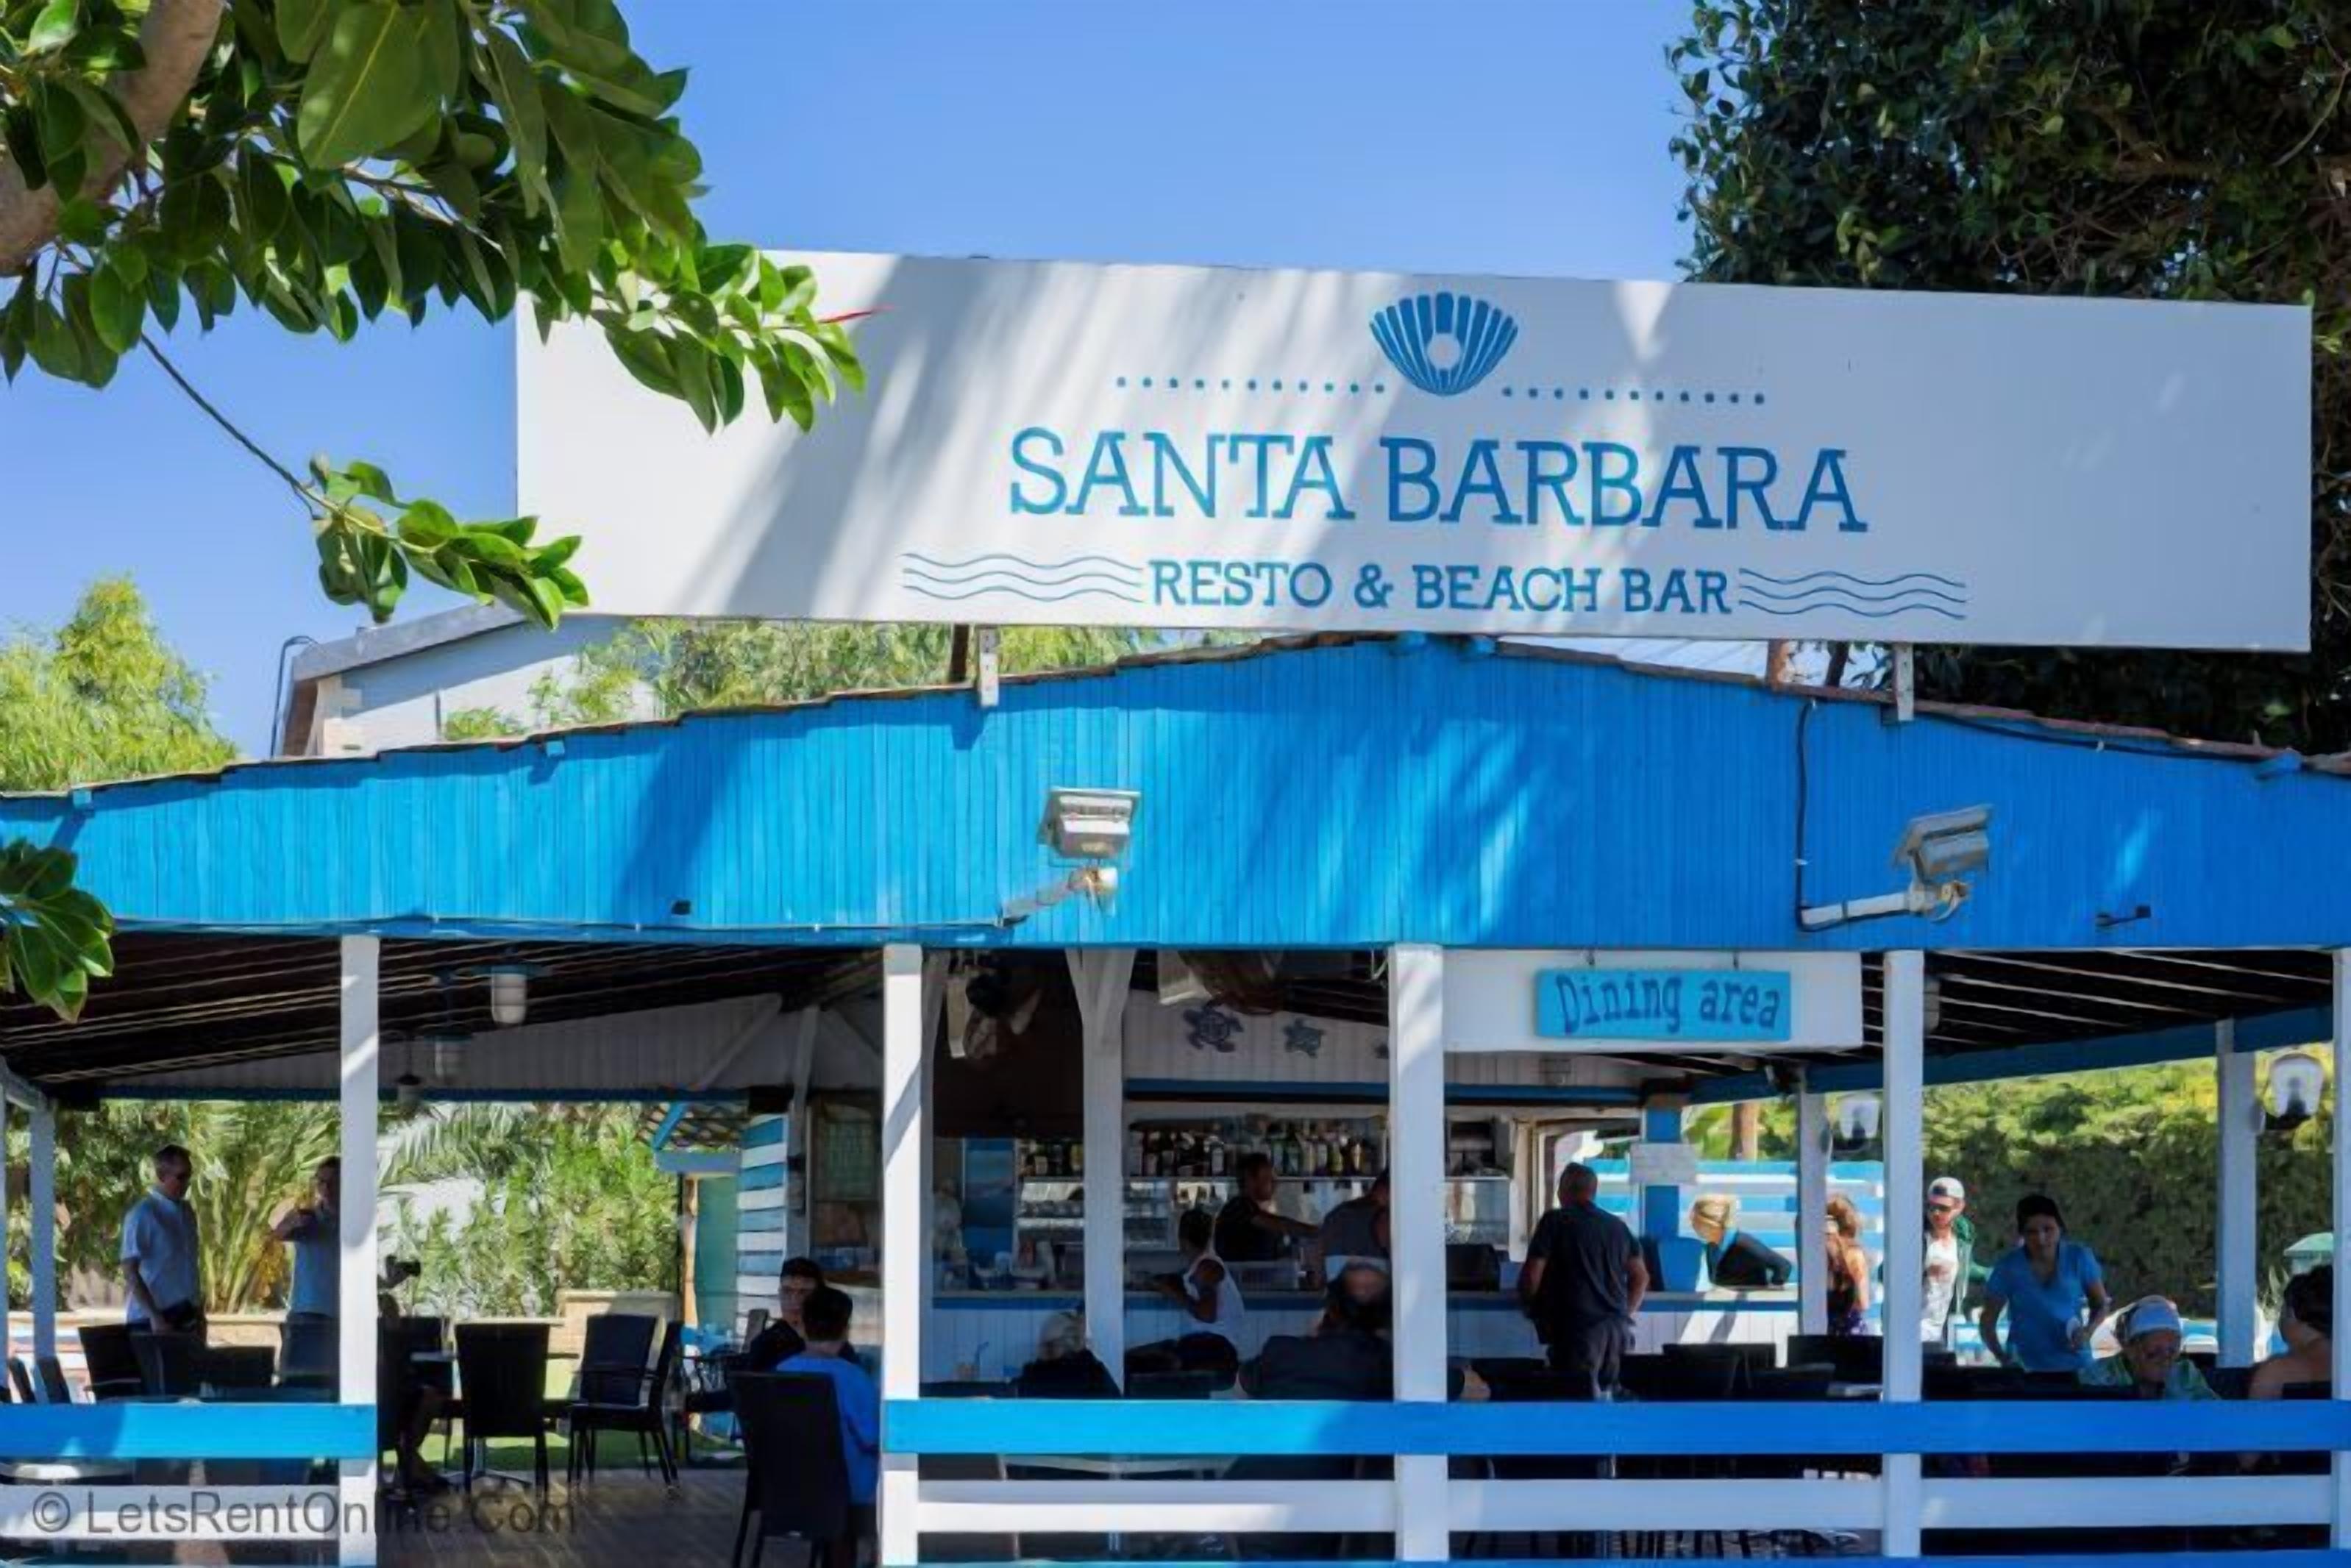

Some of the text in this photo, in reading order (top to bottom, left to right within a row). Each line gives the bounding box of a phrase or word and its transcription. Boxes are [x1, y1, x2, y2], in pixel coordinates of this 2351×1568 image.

[1011, 427, 1868, 532] SANTA BARBARA
[1149, 560, 1732, 614] RESTO & BEACH BAR
[1556, 974, 1780, 1034] Dining area
